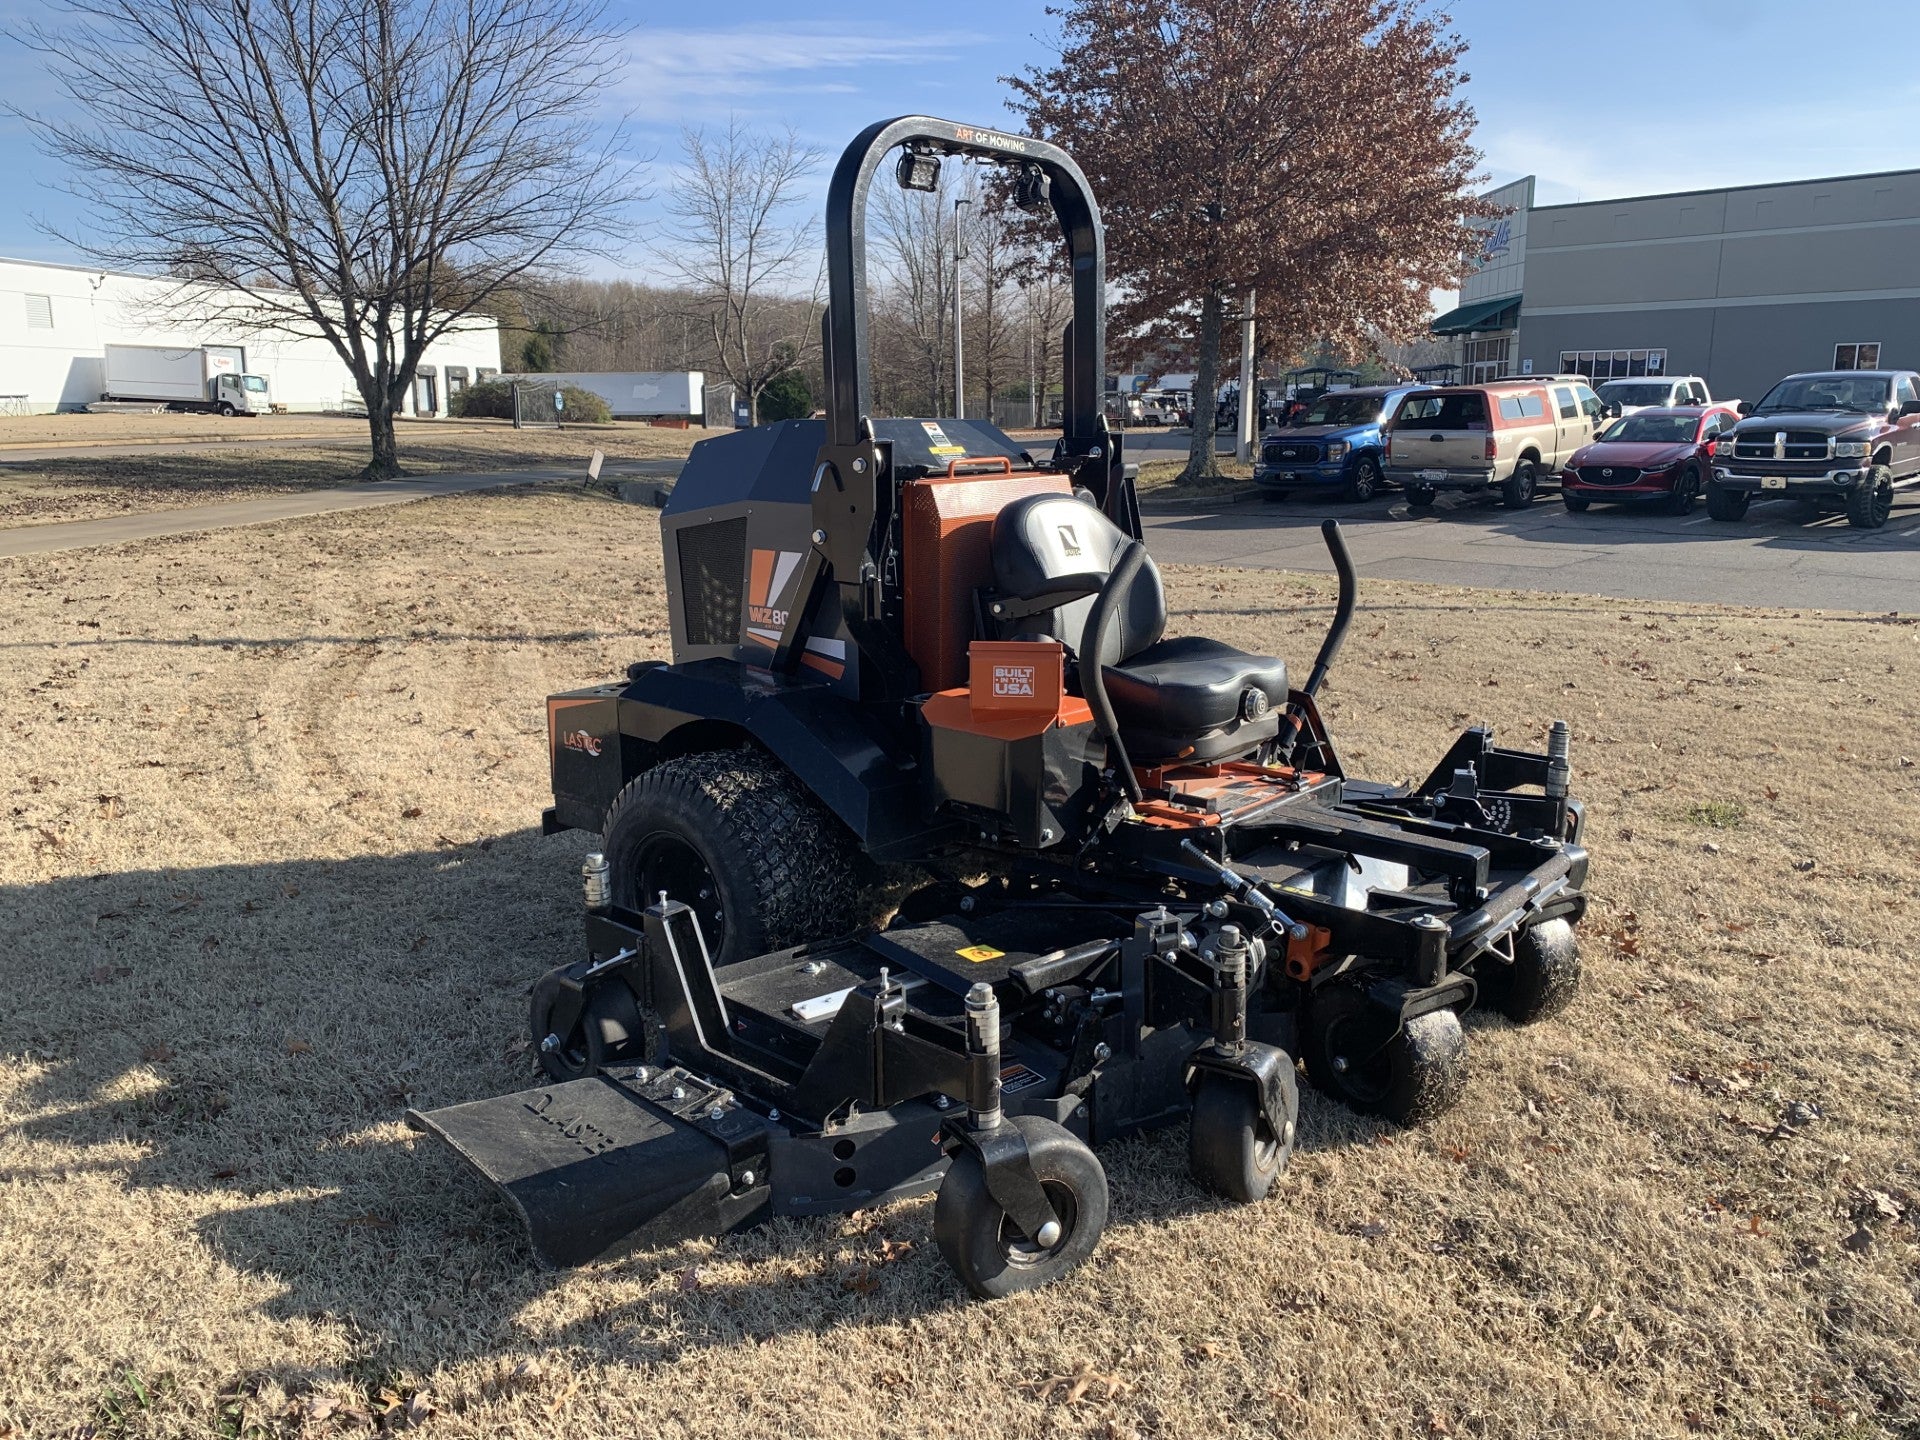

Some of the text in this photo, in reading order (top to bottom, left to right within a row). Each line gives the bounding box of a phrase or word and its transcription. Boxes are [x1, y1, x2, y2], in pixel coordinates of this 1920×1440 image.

[956, 127, 1026, 152] ART OF MOWING
[995, 668, 1032, 678] BUILT
[995, 683, 1033, 695] USA
[563, 730, 603, 753] LASTEC
